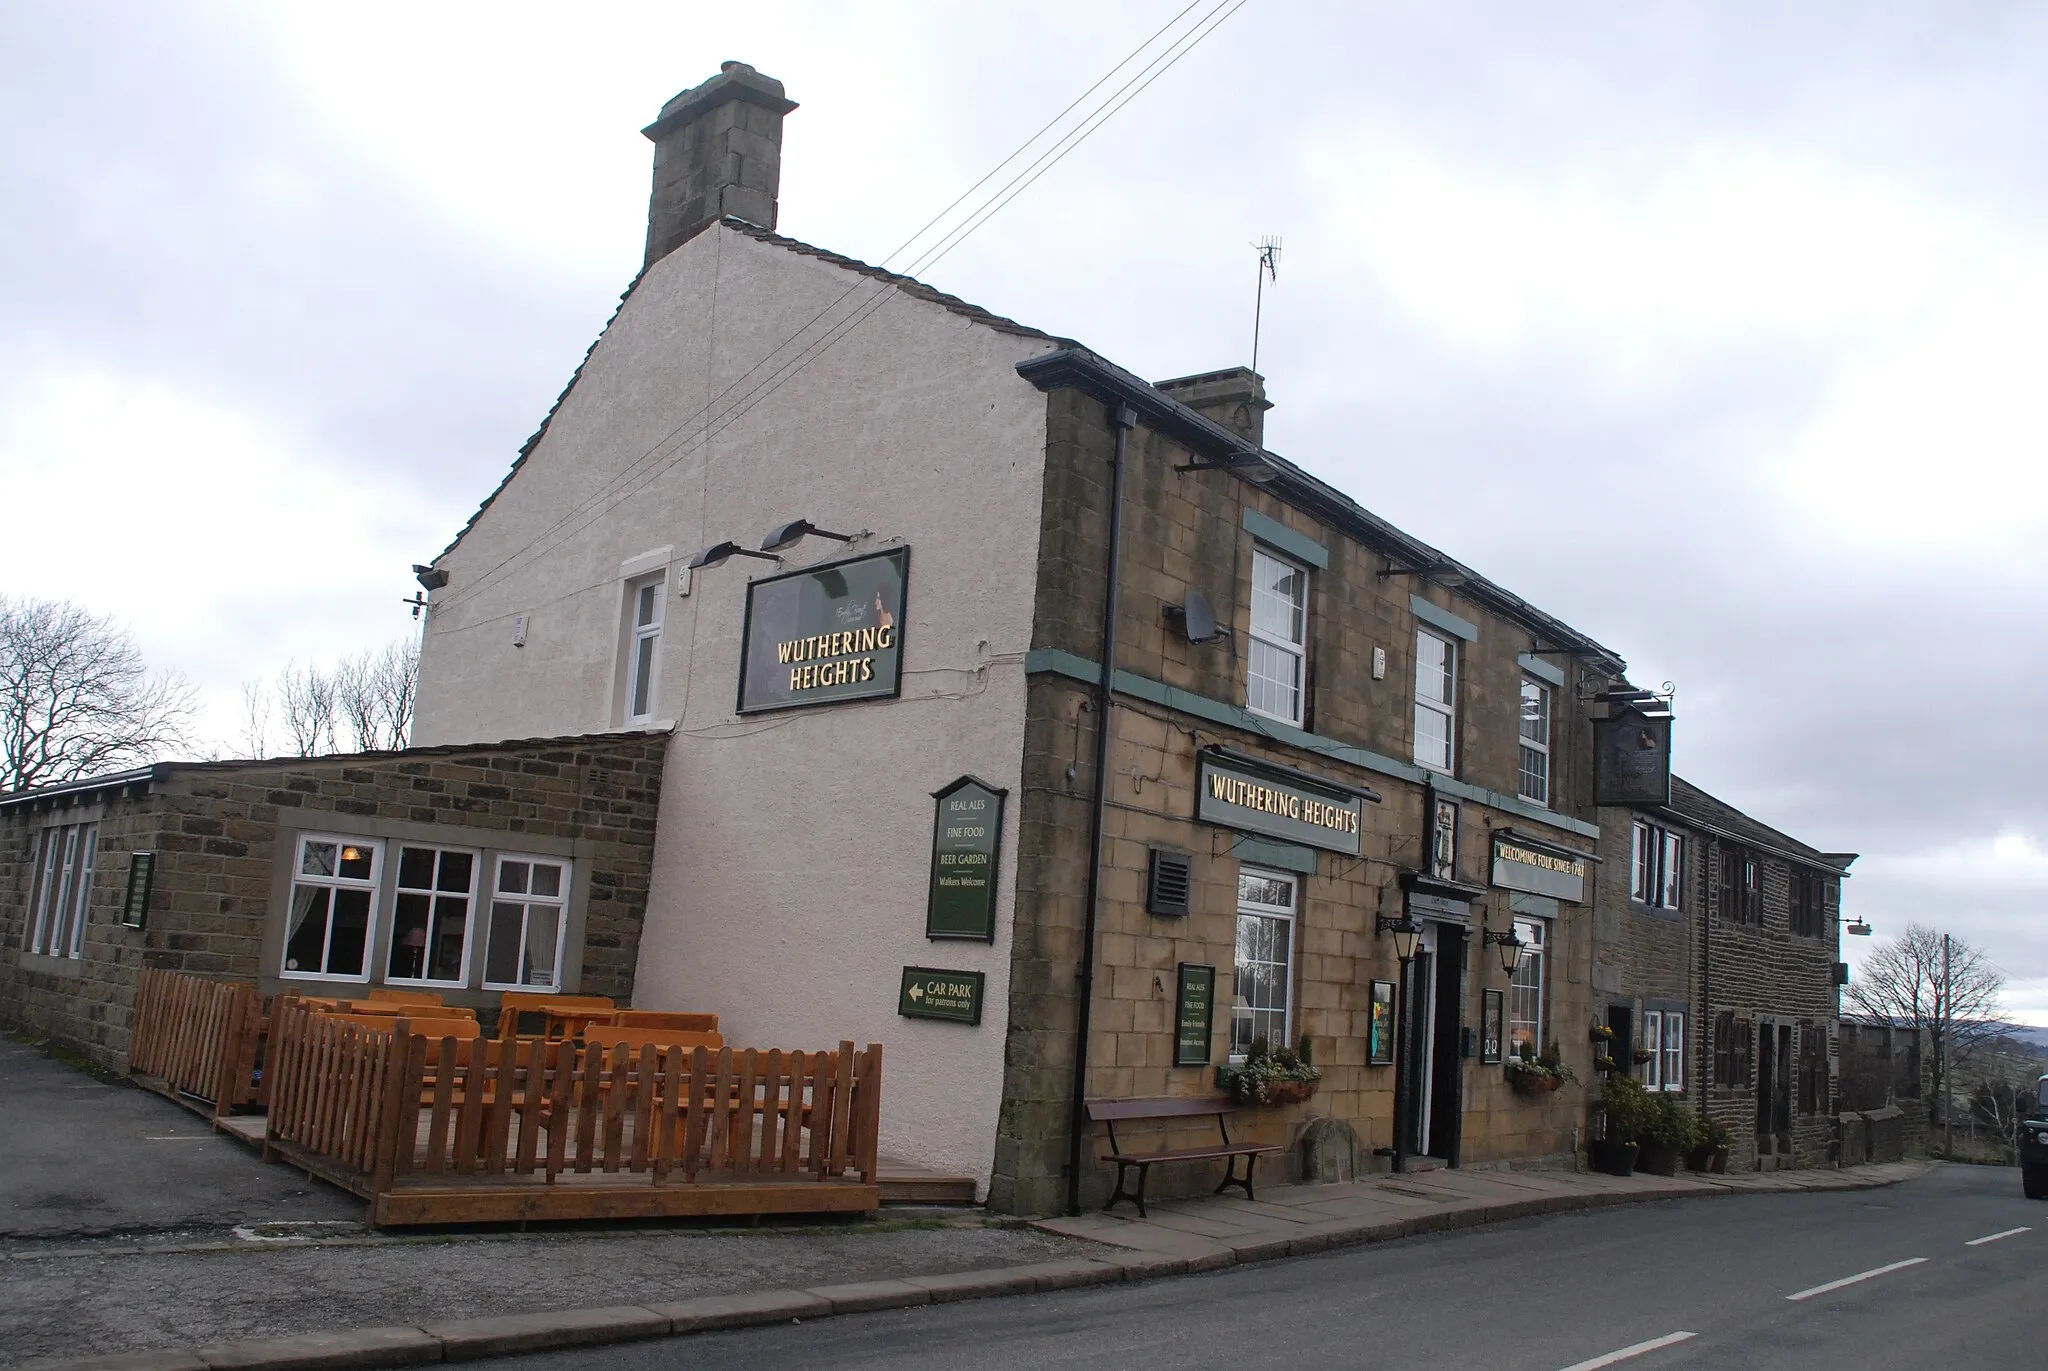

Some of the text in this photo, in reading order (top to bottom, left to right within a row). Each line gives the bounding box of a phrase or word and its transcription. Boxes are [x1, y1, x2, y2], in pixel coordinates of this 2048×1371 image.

[778, 624, 893, 664] WUTHERING
[789, 657, 872, 691] HEIGHTS
[950, 799, 985, 812] REAL ALES
[1212, 773, 1357, 834] WUTHERING HEIGHTS
[947, 826, 985, 838] FINE FOOD
[940, 853, 987, 865] BEER GARDEN
[1499, 844, 1537, 866] WELCOMING
[1537, 854, 1552, 870] FOLK
[1553, 858, 1570, 873] SINCE
[939, 876, 985, 887] Walkers Welcome
[927, 981, 971, 998] CAR PARK
[925, 996, 970, 1010] for patrons only
